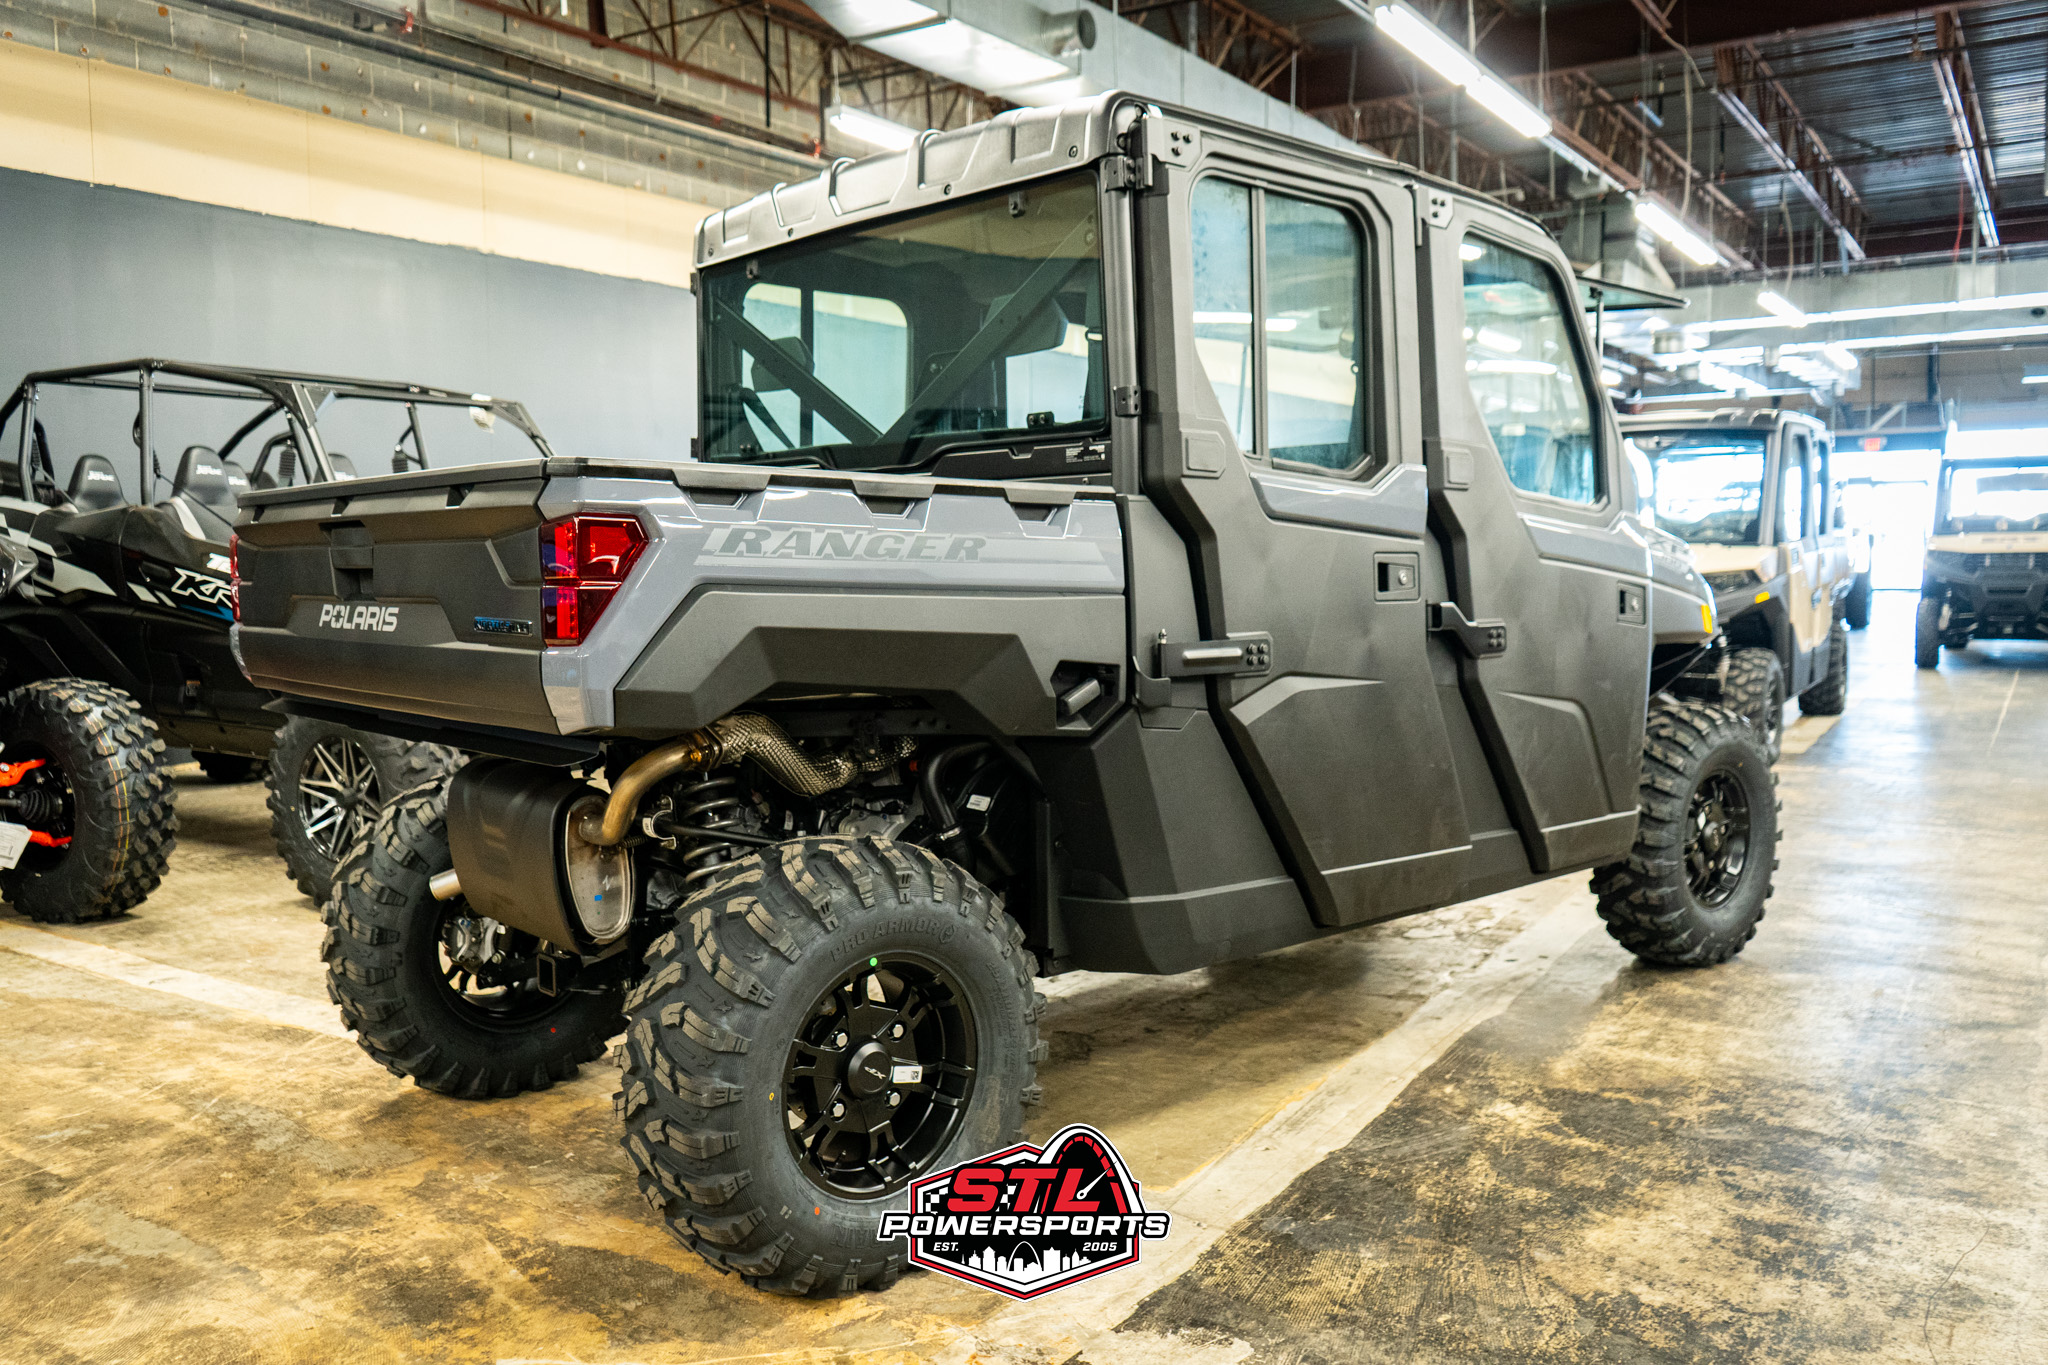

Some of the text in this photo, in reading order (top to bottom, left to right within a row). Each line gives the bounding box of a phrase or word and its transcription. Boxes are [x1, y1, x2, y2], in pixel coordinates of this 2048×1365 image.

[716, 526, 987, 562] RANGER
[319, 604, 399, 632] POLARIS
[872, 917, 940, 939] ARMOR
